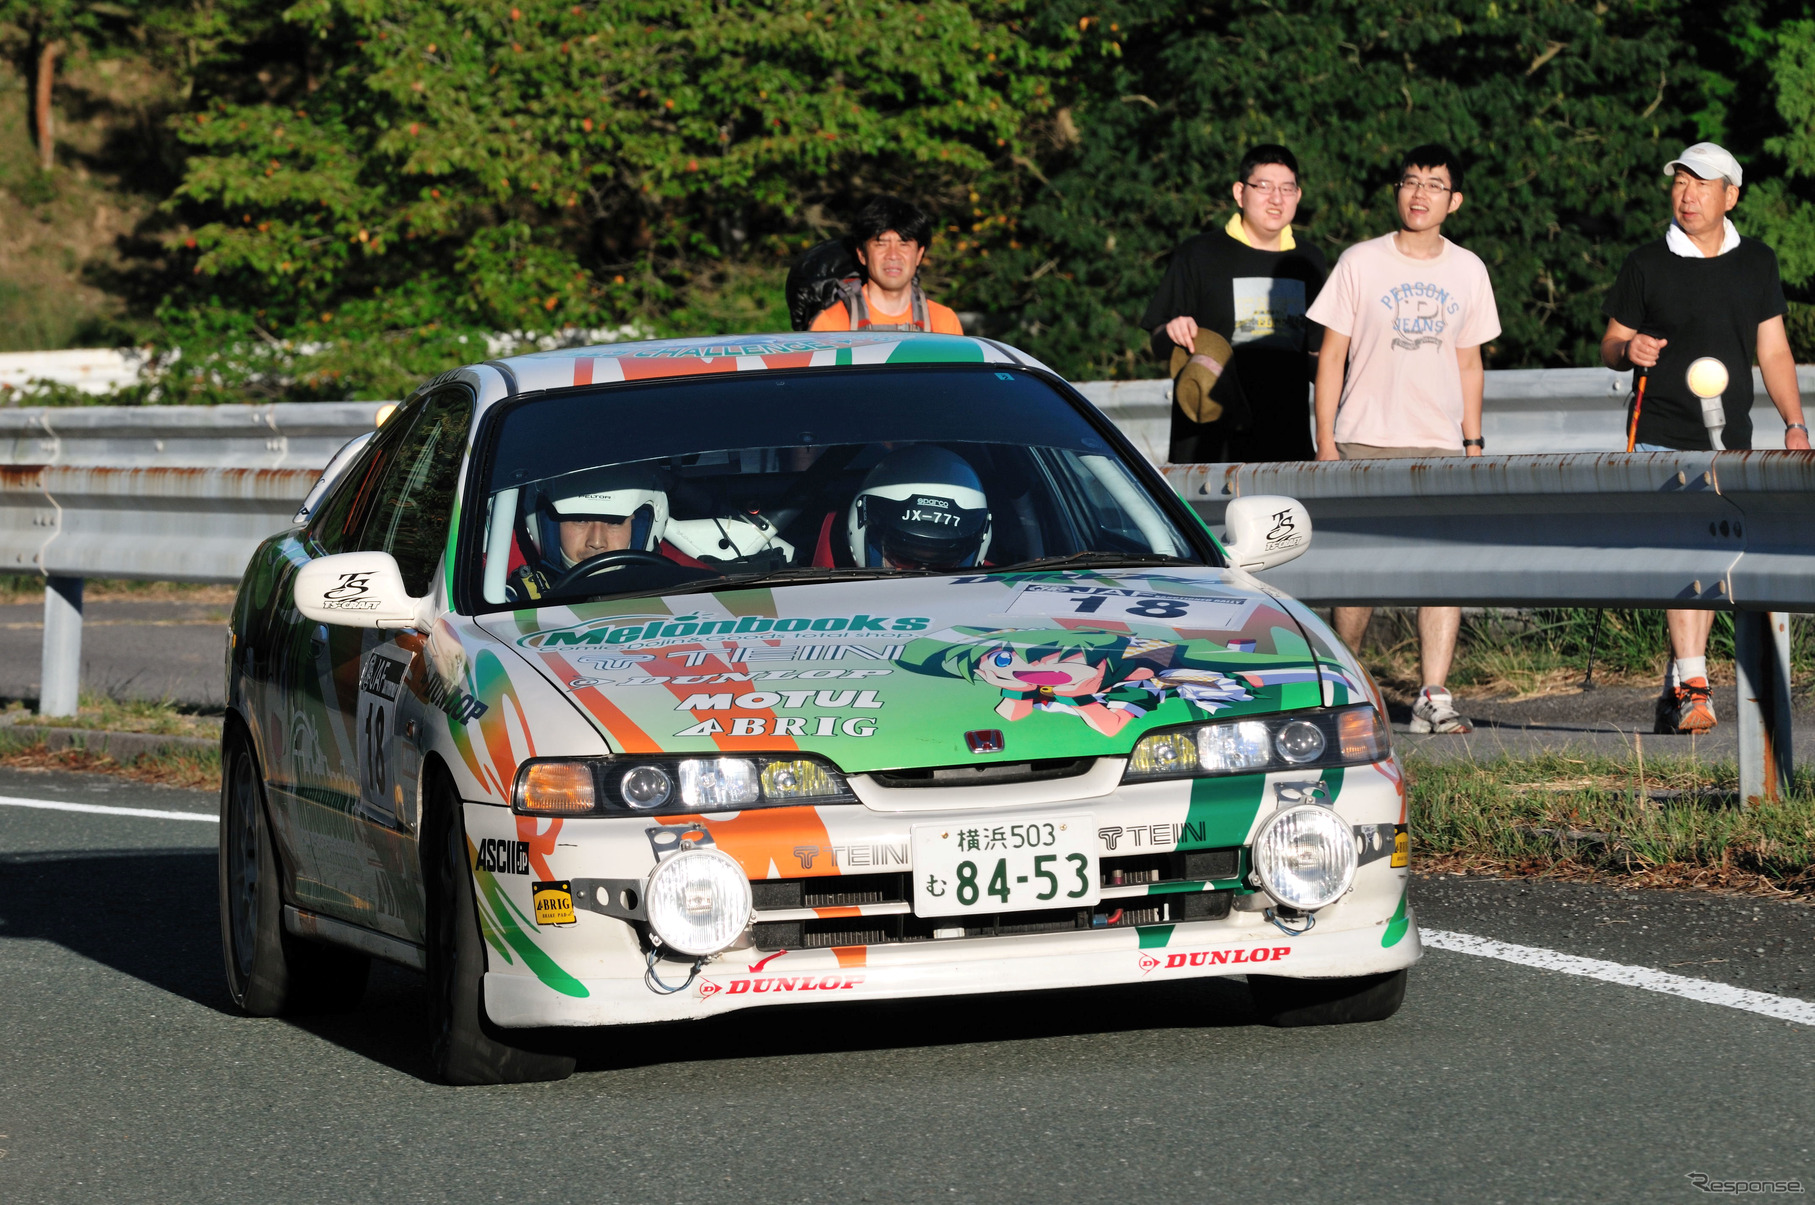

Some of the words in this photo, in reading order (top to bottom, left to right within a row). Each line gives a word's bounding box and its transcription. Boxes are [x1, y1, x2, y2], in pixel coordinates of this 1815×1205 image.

[1380, 282, 1459, 315] PERSON'S
[1393, 318, 1445, 333] JEANS
[633, 340, 836, 358] CHALLENGE
[902, 510, 960, 527] JX-777
[1070, 596, 1190, 618] 18
[543, 614, 929, 646] Melonbooks
[665, 644, 906, 668] TEIN
[617, 668, 893, 687] DUNLOP
[674, 689, 885, 711] MOTUL
[365, 702, 385, 795] 18
[1126, 821, 1207, 846] TEIN
[824, 843, 908, 868] TEIN
[926, 874, 947, 897] む
[956, 853, 1090, 906] 84-53
[1164, 947, 1291, 968] DUNLOP
[725, 975, 867, 995] DUNLOP
